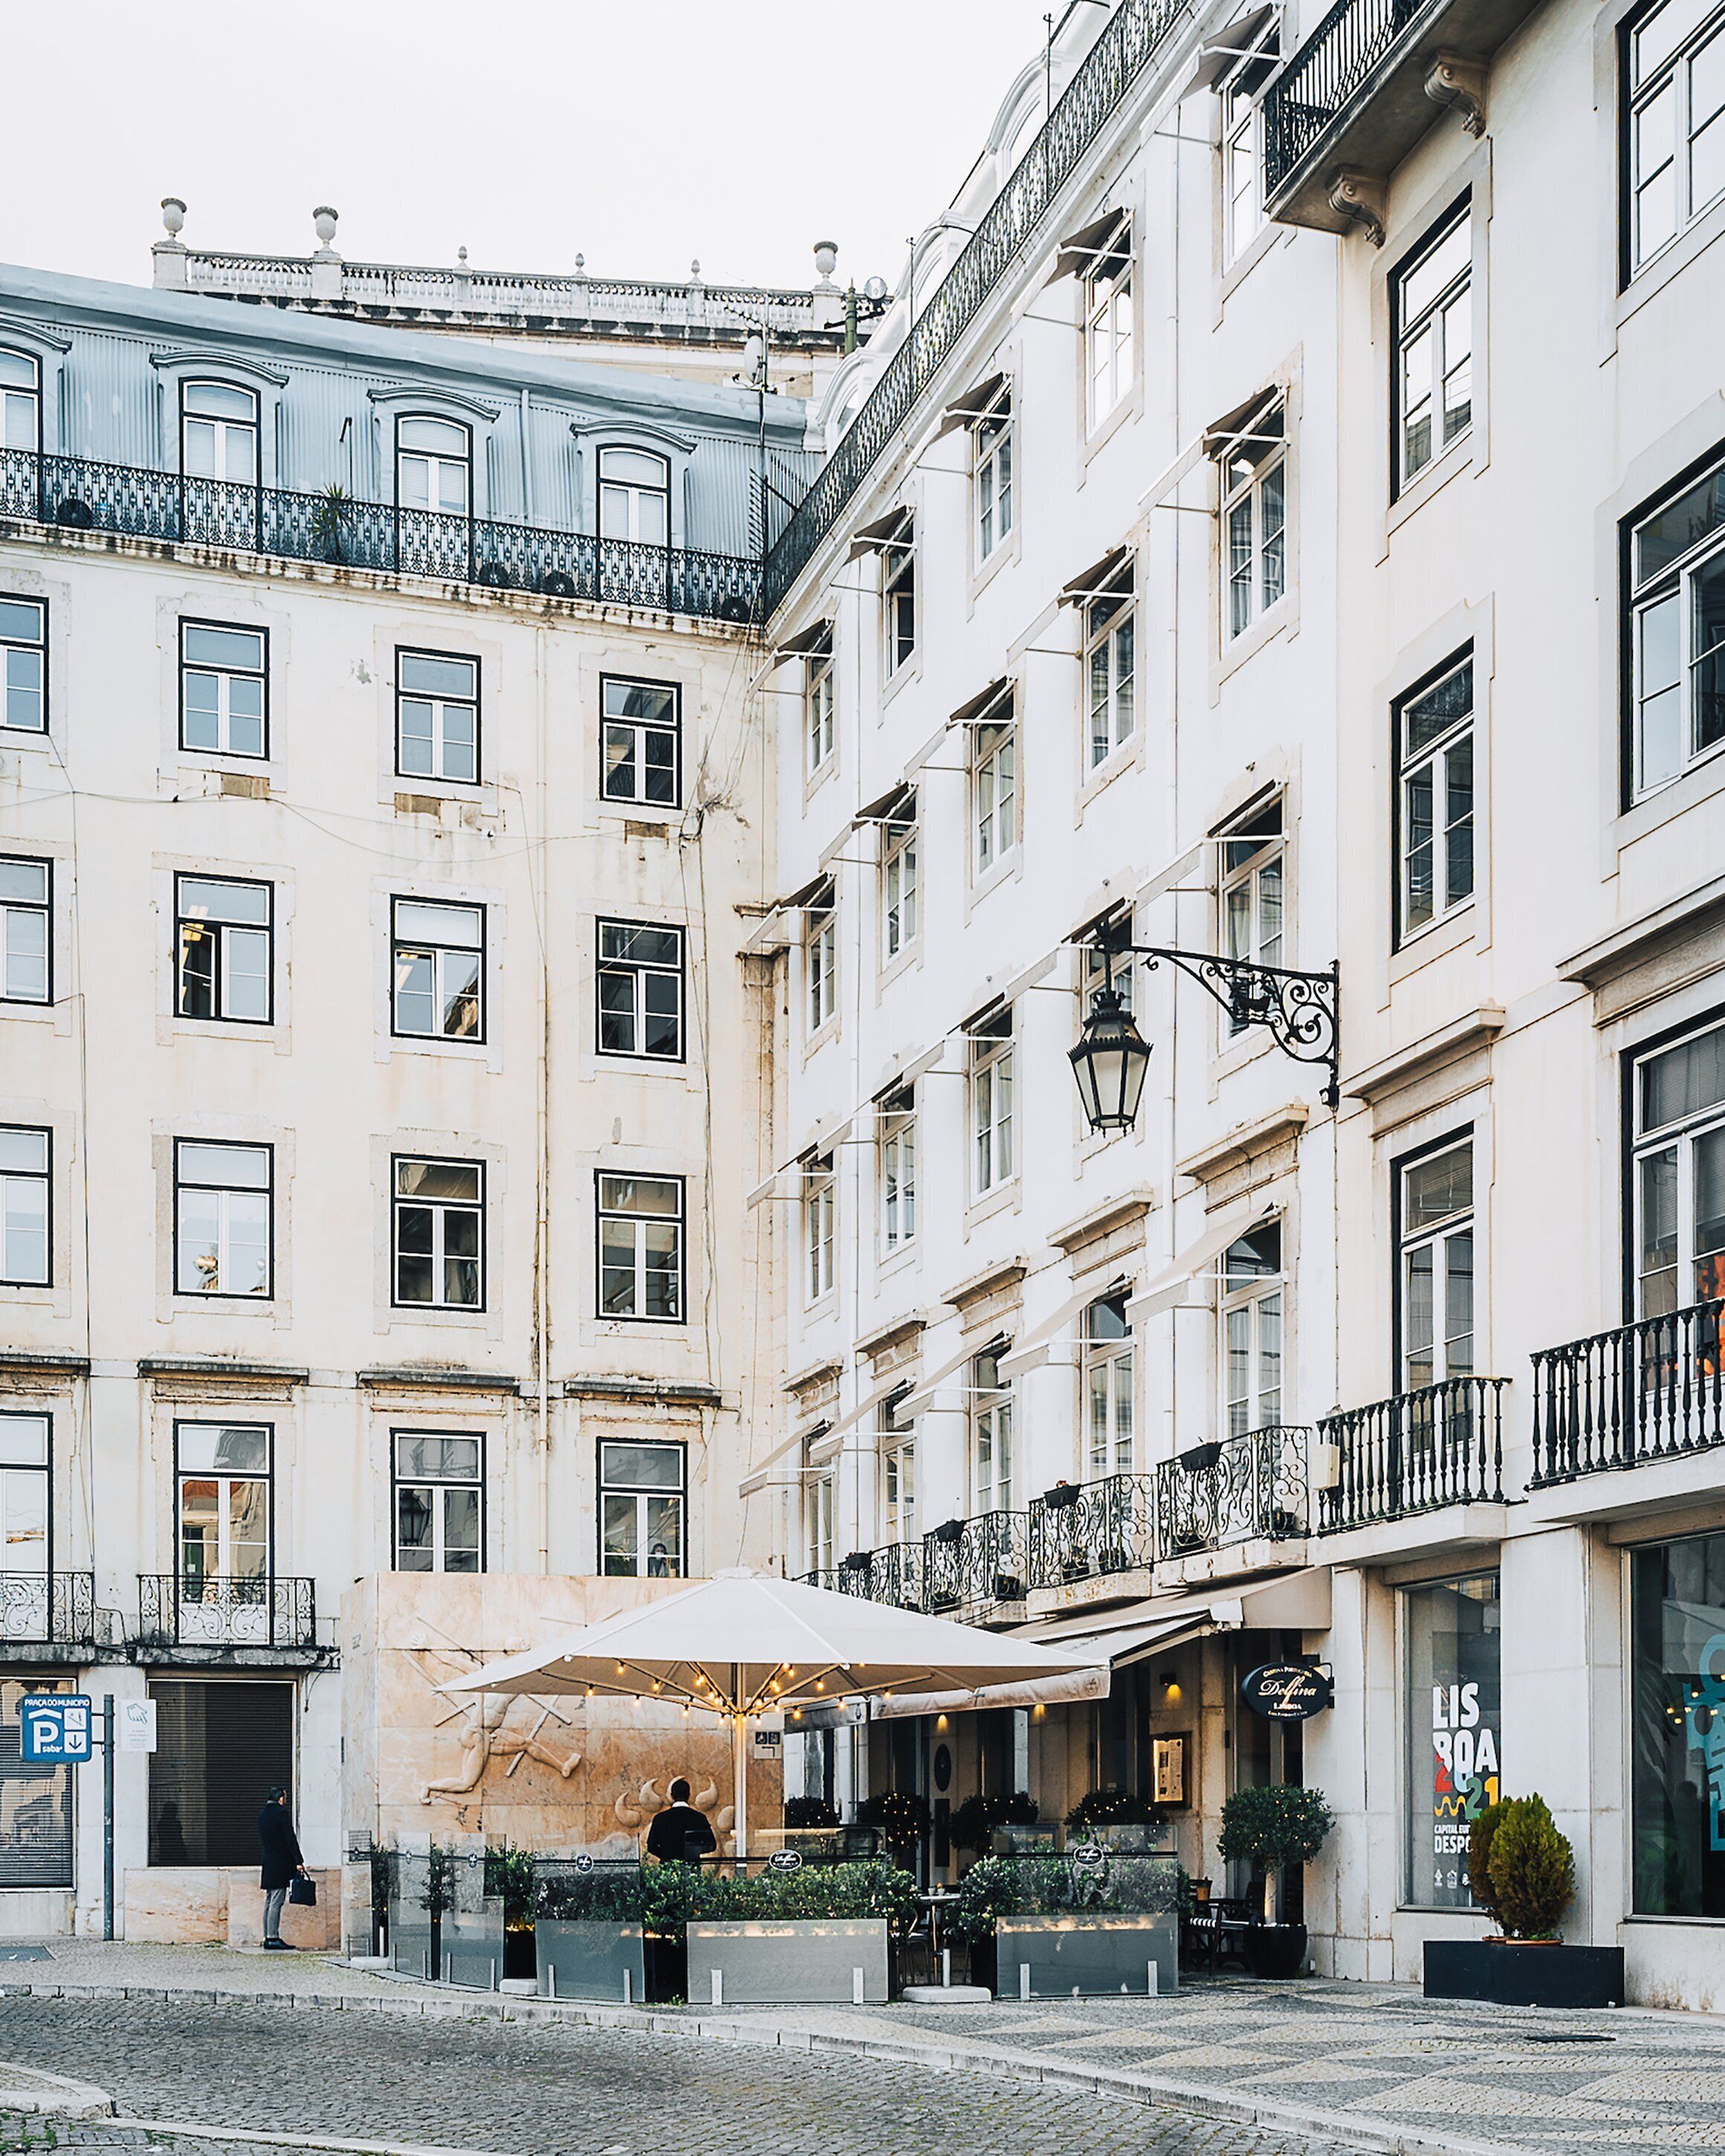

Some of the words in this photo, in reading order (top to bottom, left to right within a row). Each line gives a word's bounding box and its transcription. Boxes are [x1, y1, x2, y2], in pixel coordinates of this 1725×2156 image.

[25, 1699, 46, 1708] PRAÇA
[1257, 1675, 1318, 1707] Delfina
[1432, 1682, 1480, 1729] LIS
[33, 1721, 59, 1754] P
[1432, 1729, 1499, 1773] BOA
[1434, 1824, 1458, 1834] CAPITAL
